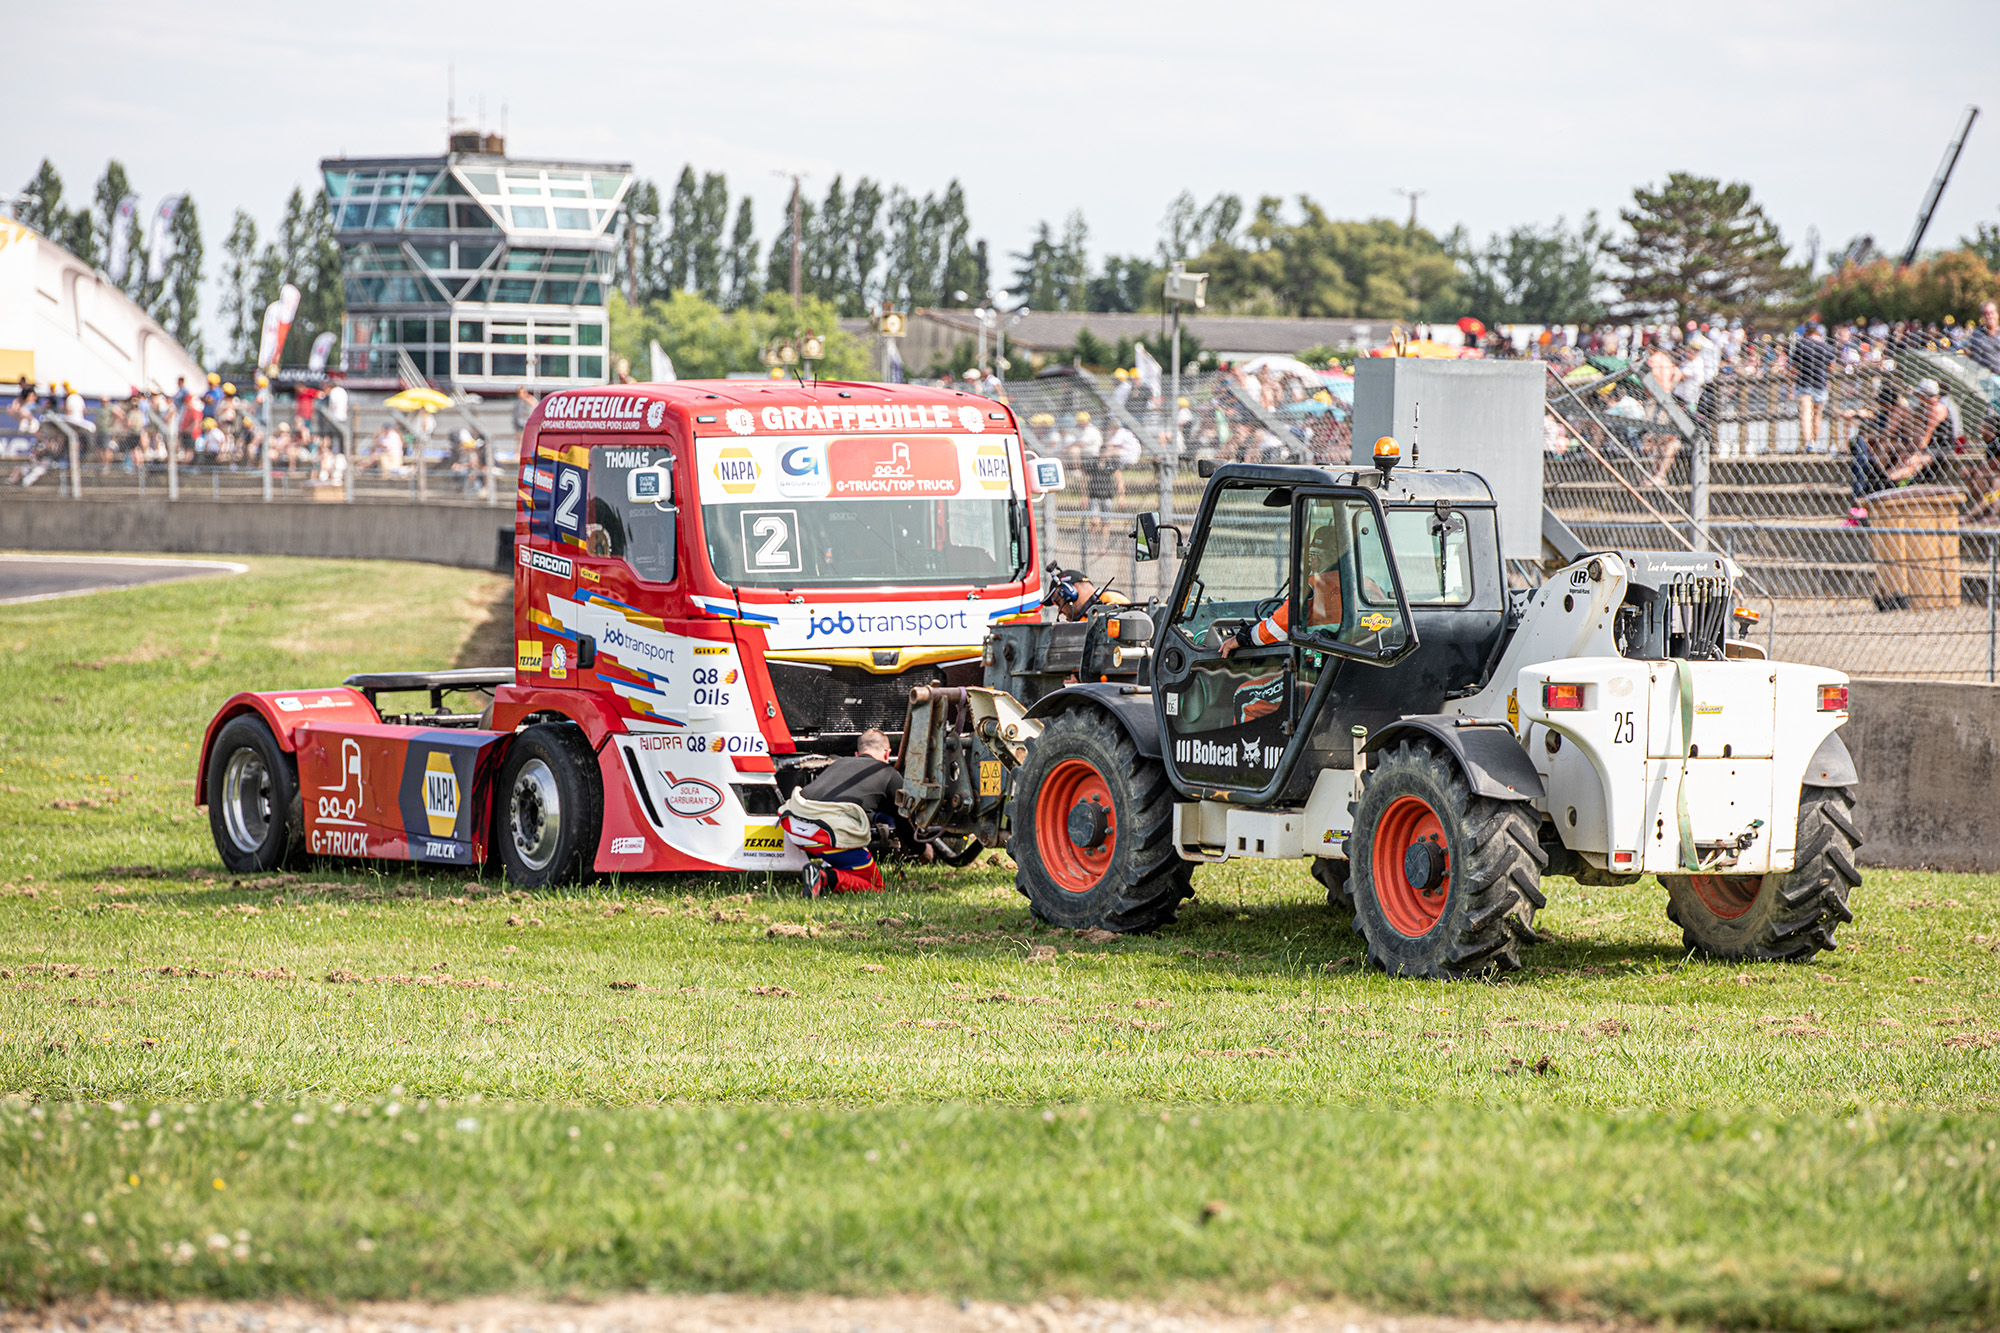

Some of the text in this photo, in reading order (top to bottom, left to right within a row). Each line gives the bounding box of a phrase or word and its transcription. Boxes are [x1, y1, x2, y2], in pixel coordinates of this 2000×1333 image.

[544, 396, 649, 419] GRAFFEUILLE
[761, 404, 953, 430] GRAFFEUILLE
[605, 451, 649, 469] THOMAS
[978, 458, 1008, 477] NAPA
[721, 461, 755, 480] NAPA
[836, 480, 955, 492] G-TRUCK/TOP TRUCK
[554, 468, 582, 531] 2
[753, 516, 791, 566] 2
[533, 553, 570, 575] FACOM
[1574, 570, 1587, 584] IR
[519, 656, 541, 667] TEXTAR
[693, 668, 718, 685] Q8
[694, 688, 729, 706] Oils
[1613, 711, 1635, 744] 25
[686, 735, 706, 753] Q8
[727, 735, 764, 753] Oils
[1192, 740, 1238, 768] Bobcat
[429, 776, 455, 812] NAPA
[680, 787, 700, 795] SOLFA
[670, 796, 715, 805] CARBURANTS
[312, 830, 368, 857] G-TRUCK
[426, 842, 457, 859] TRUCK
[744, 838, 784, 848] TEXTAR
